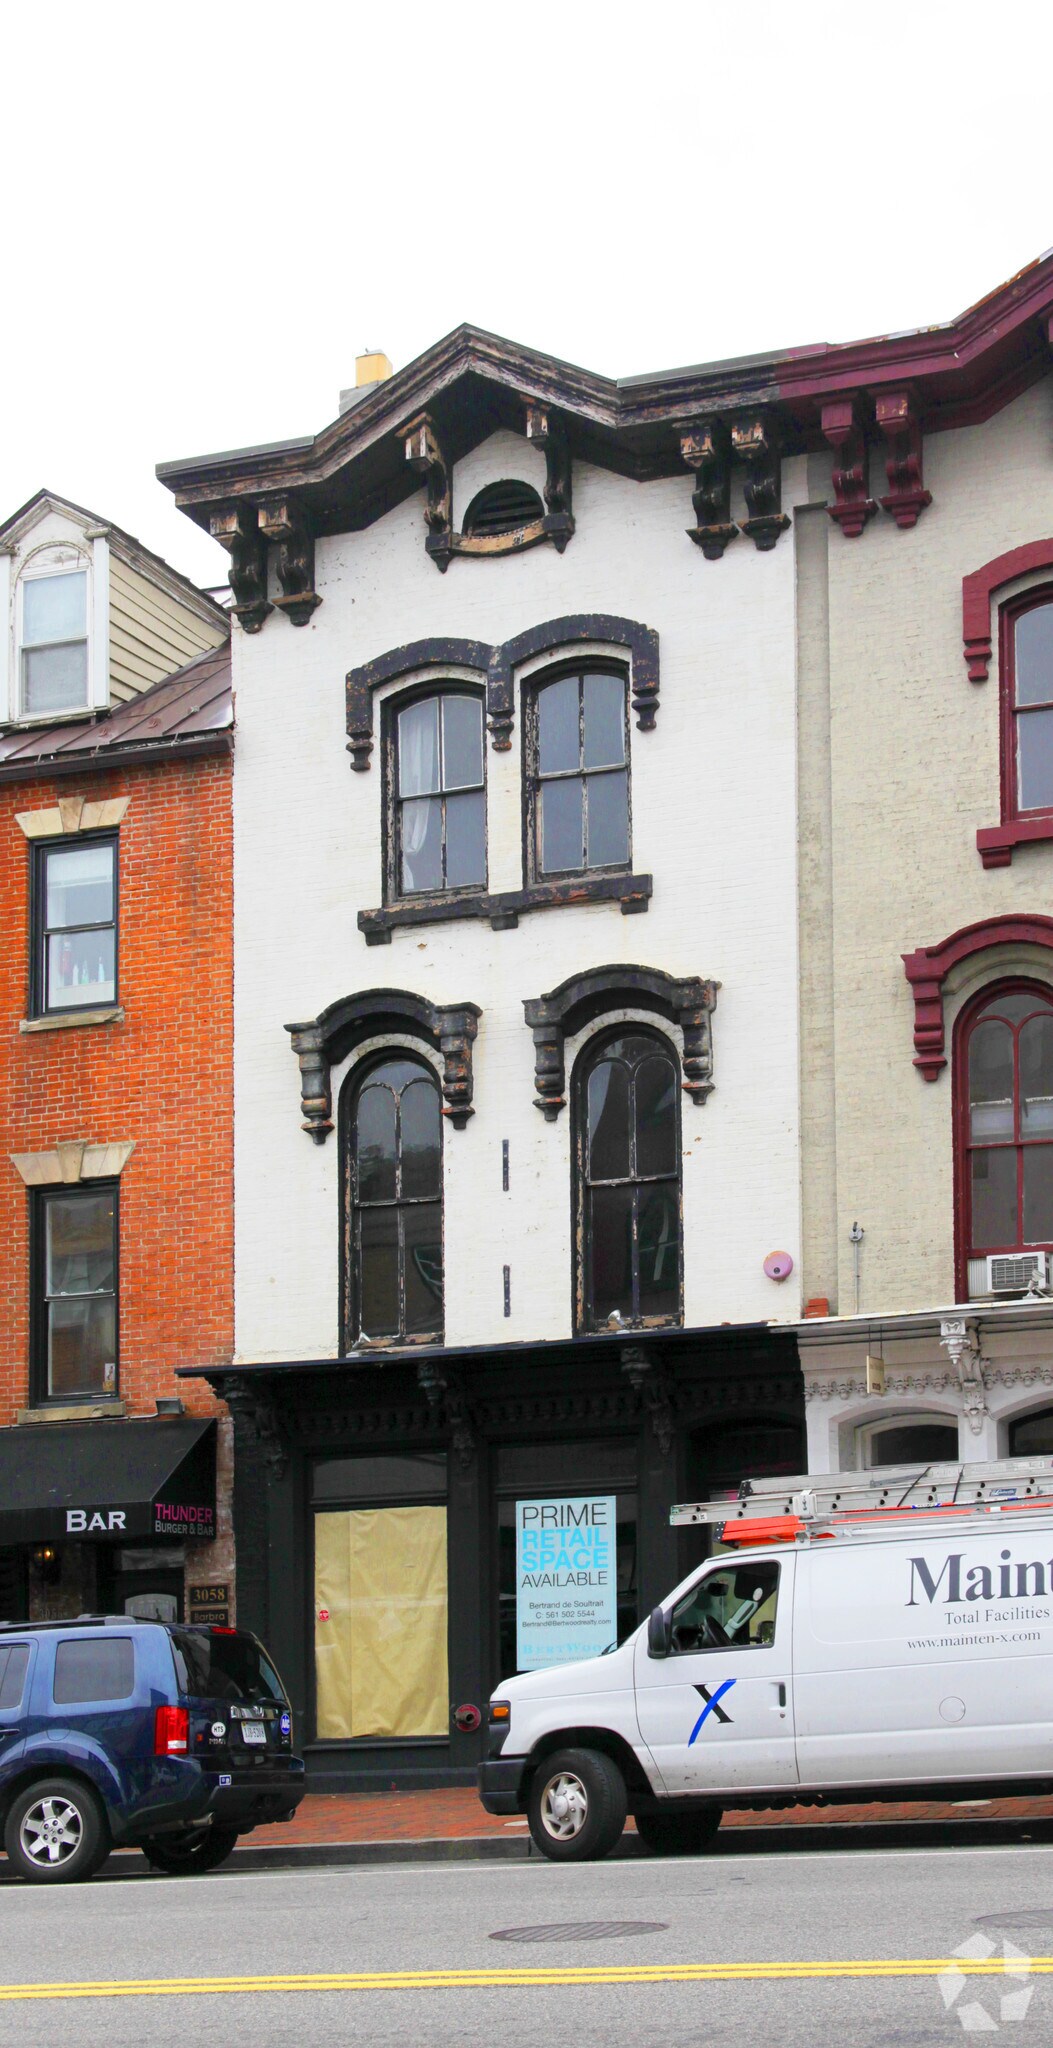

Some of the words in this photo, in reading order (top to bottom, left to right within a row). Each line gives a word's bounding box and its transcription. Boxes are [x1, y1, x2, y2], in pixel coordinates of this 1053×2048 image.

[66, 1510, 126, 1532] BAR
[155, 1503, 213, 1523] THUNDER
[522, 1503, 607, 1529] PRIME
[155, 1520, 187, 1534] BURGER
[189, 1523, 196, 1535] &
[197, 1523, 213, 1536] BAR
[522, 1528, 608, 1549] RETAIL
[521, 1548, 609, 1571] SPACE
[521, 1571, 608, 1588] AVAILABLE
[193, 1588, 225, 1602] 3058
[529, 1602, 560, 1610] Bertrand
[562, 1601, 572, 1609] de
[573, 1600, 604, 1608] Soultrait
[194, 1612, 225, 1621] Barbra
[545, 1611, 559, 1619] 561
[577, 1610, 595, 1618] 5544
[945, 1611, 980, 1625] Total
[985, 1606, 1050, 1622] Facilities
[907, 1631, 1041, 1649] www.mainten-x.com
